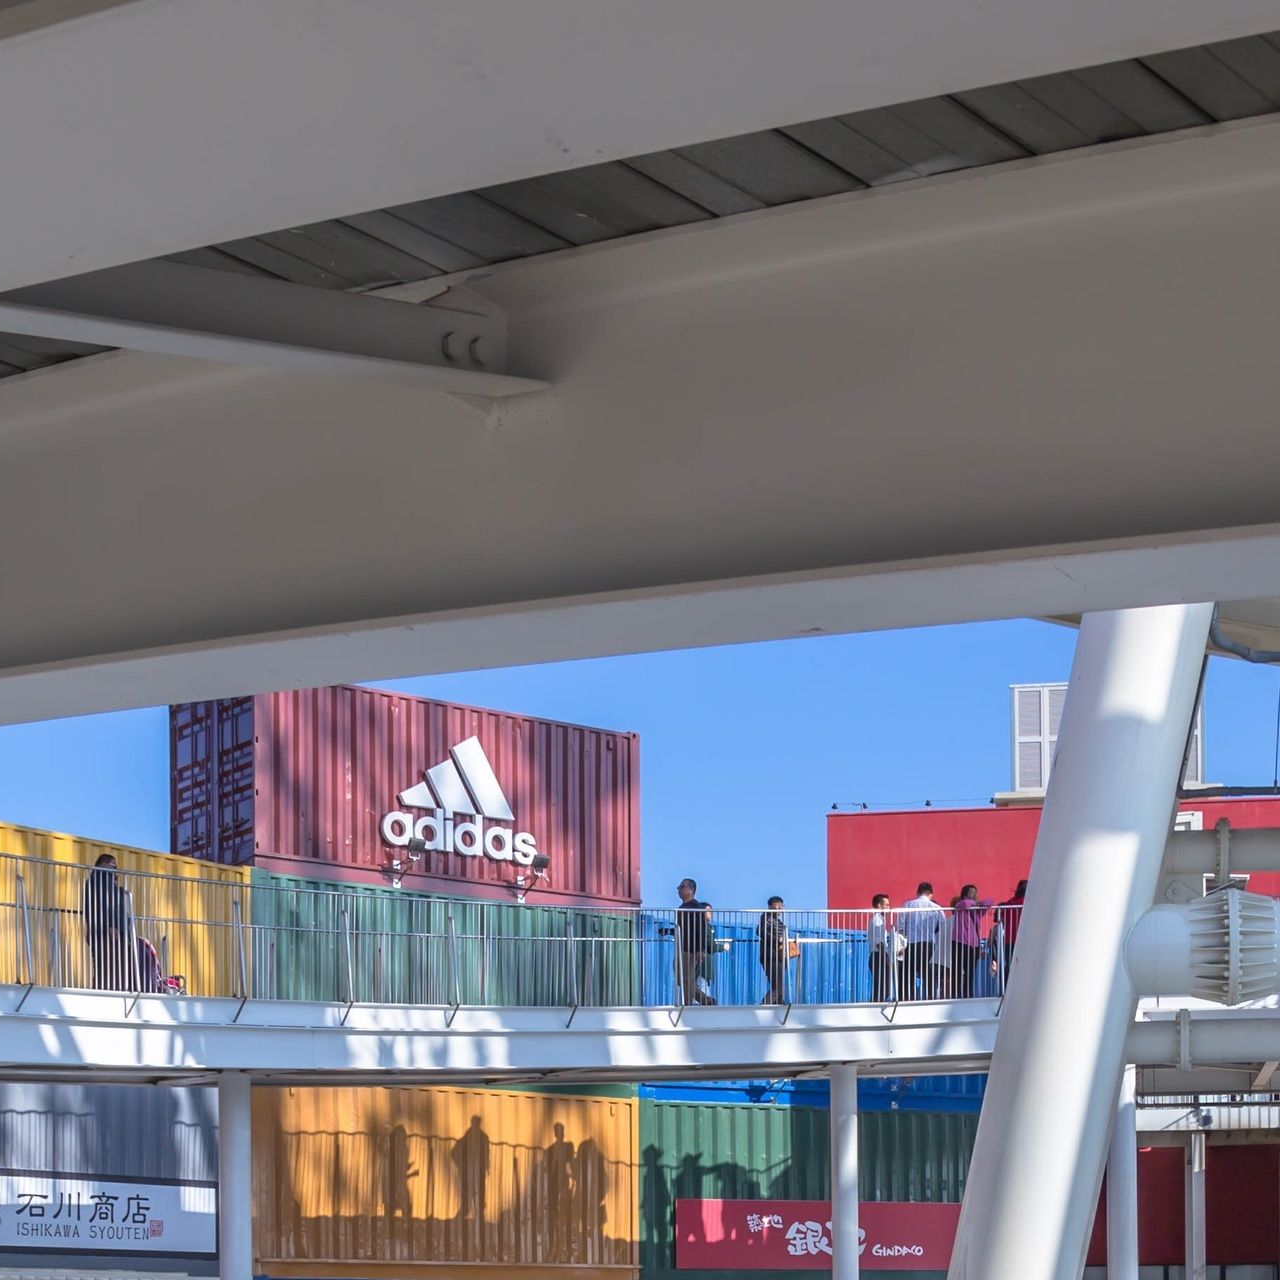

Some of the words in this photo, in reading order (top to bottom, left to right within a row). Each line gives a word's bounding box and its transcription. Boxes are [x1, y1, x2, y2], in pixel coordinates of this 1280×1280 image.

[381, 808, 538, 866] adidas
[16, 1192, 151, 1224] 石川商店
[16, 1222, 80, 1238] ISHIKAWA
[89, 1226, 150, 1241] SYOUTEN
[872, 1244, 924, 1257] GINDACO
